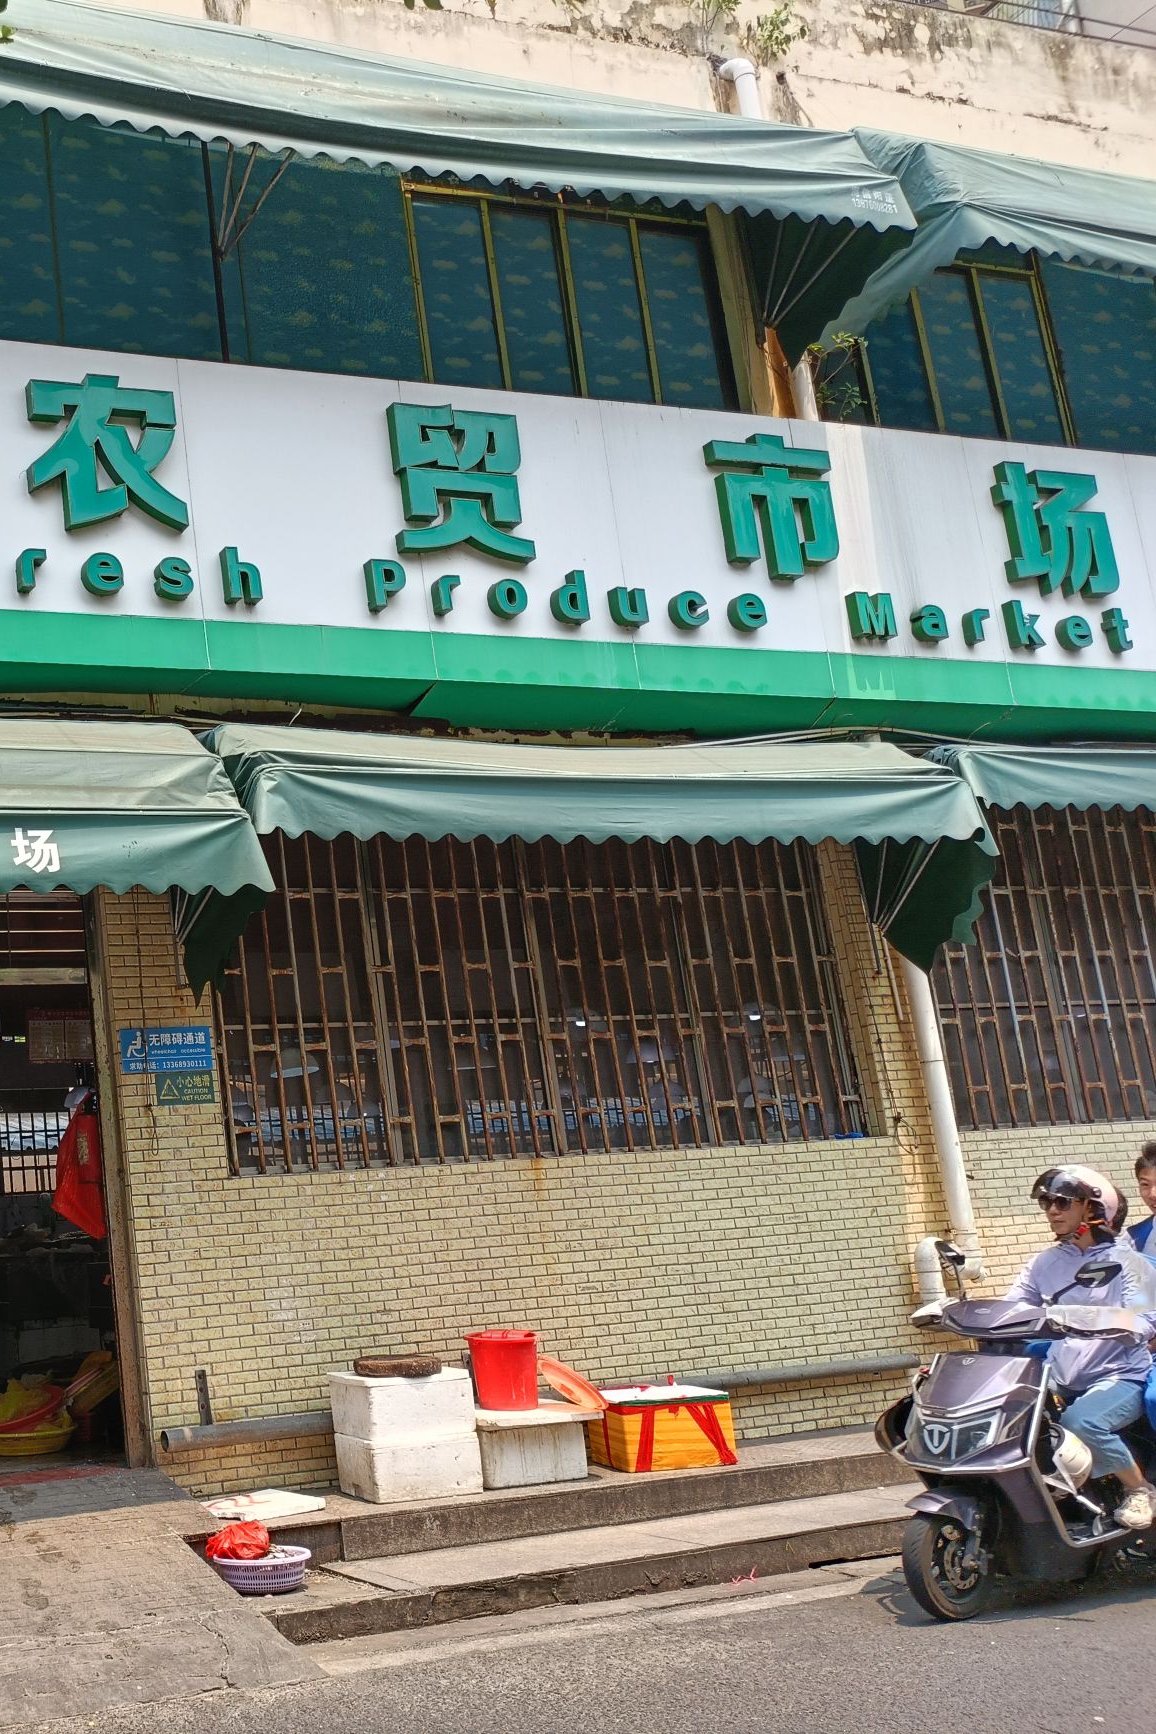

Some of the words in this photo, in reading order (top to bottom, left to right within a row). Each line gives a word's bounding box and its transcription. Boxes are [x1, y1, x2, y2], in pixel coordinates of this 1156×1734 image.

[363, 558, 768, 634] Produce
[845, 590, 1134, 654] Market
[148, 1031, 206, 1047] 无障碍通道
[162, 1059, 207, 1069] 13368930111
[176, 1074, 210, 1088] 小心地滑
